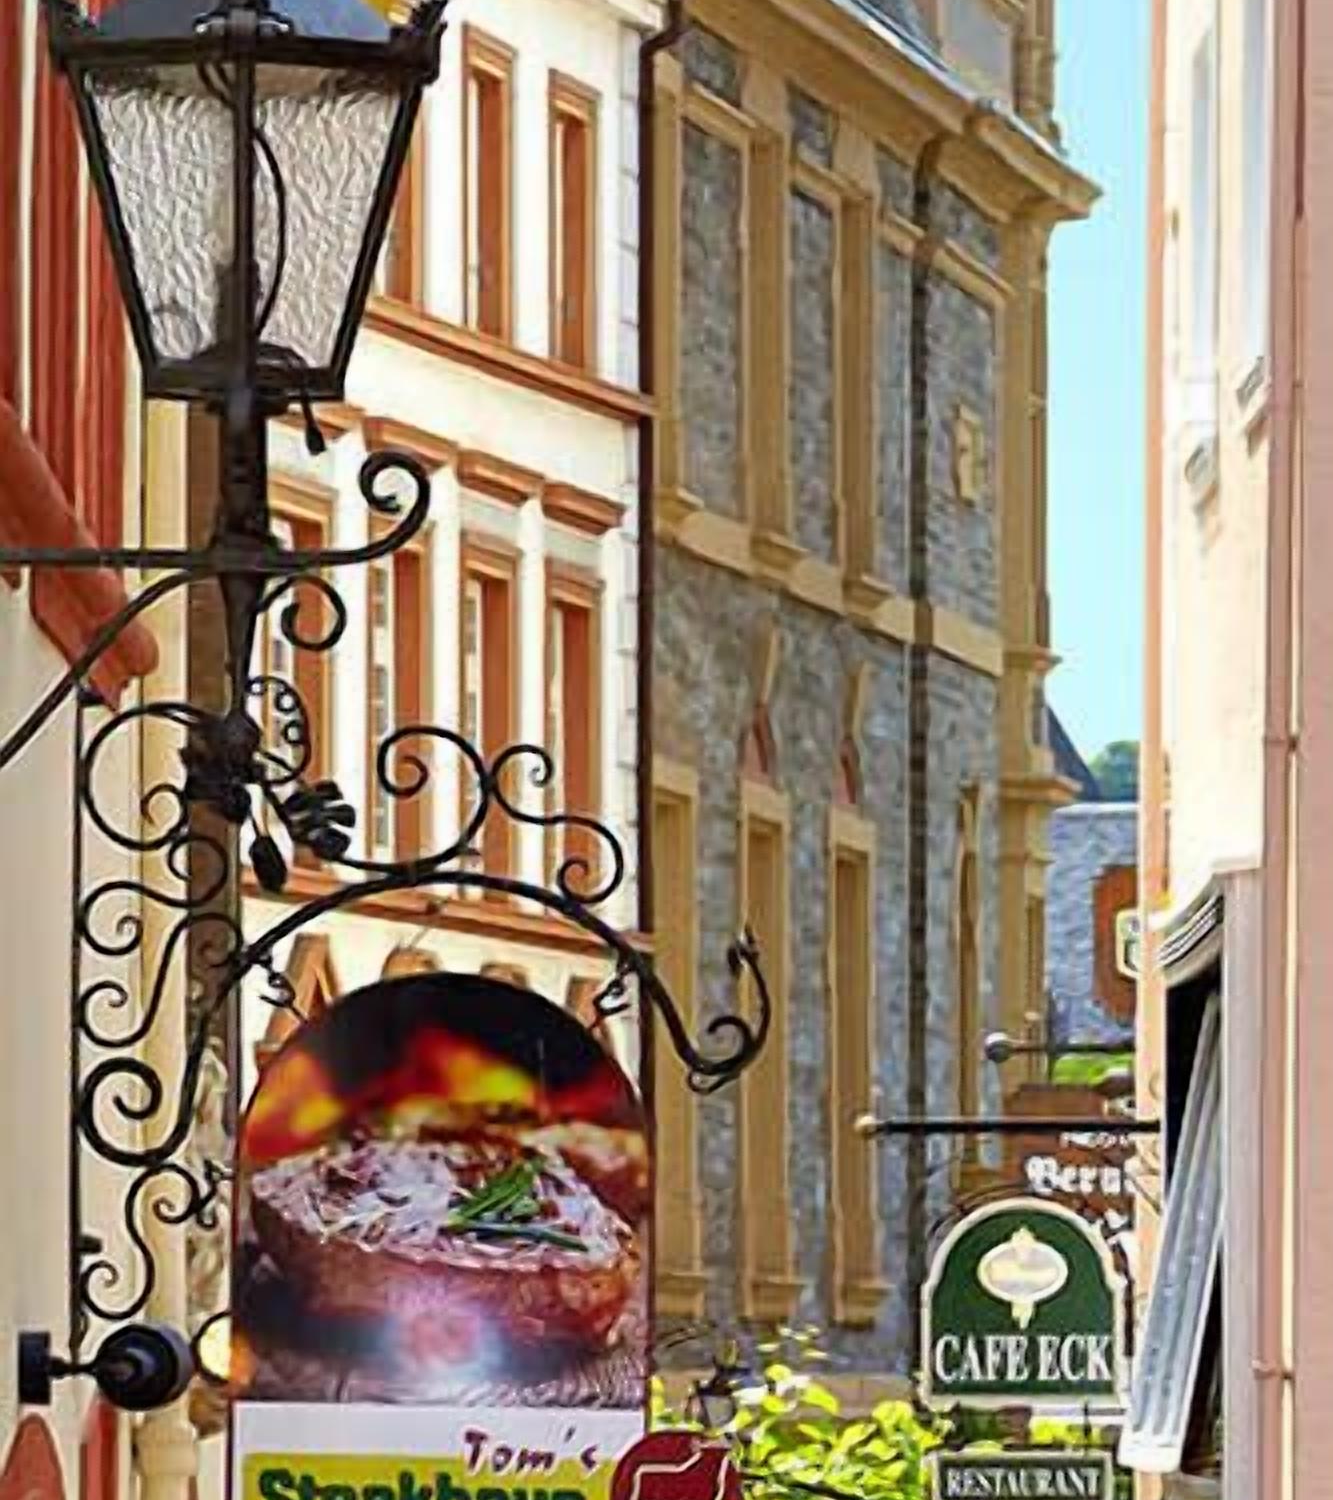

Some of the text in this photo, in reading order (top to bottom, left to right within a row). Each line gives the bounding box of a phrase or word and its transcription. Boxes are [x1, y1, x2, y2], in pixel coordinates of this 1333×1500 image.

[935, 1333, 1112, 1384] CAFE ECK
[463, 1426, 599, 1476] Tom's
[946, 1466, 1100, 1498] RESTAURANT
